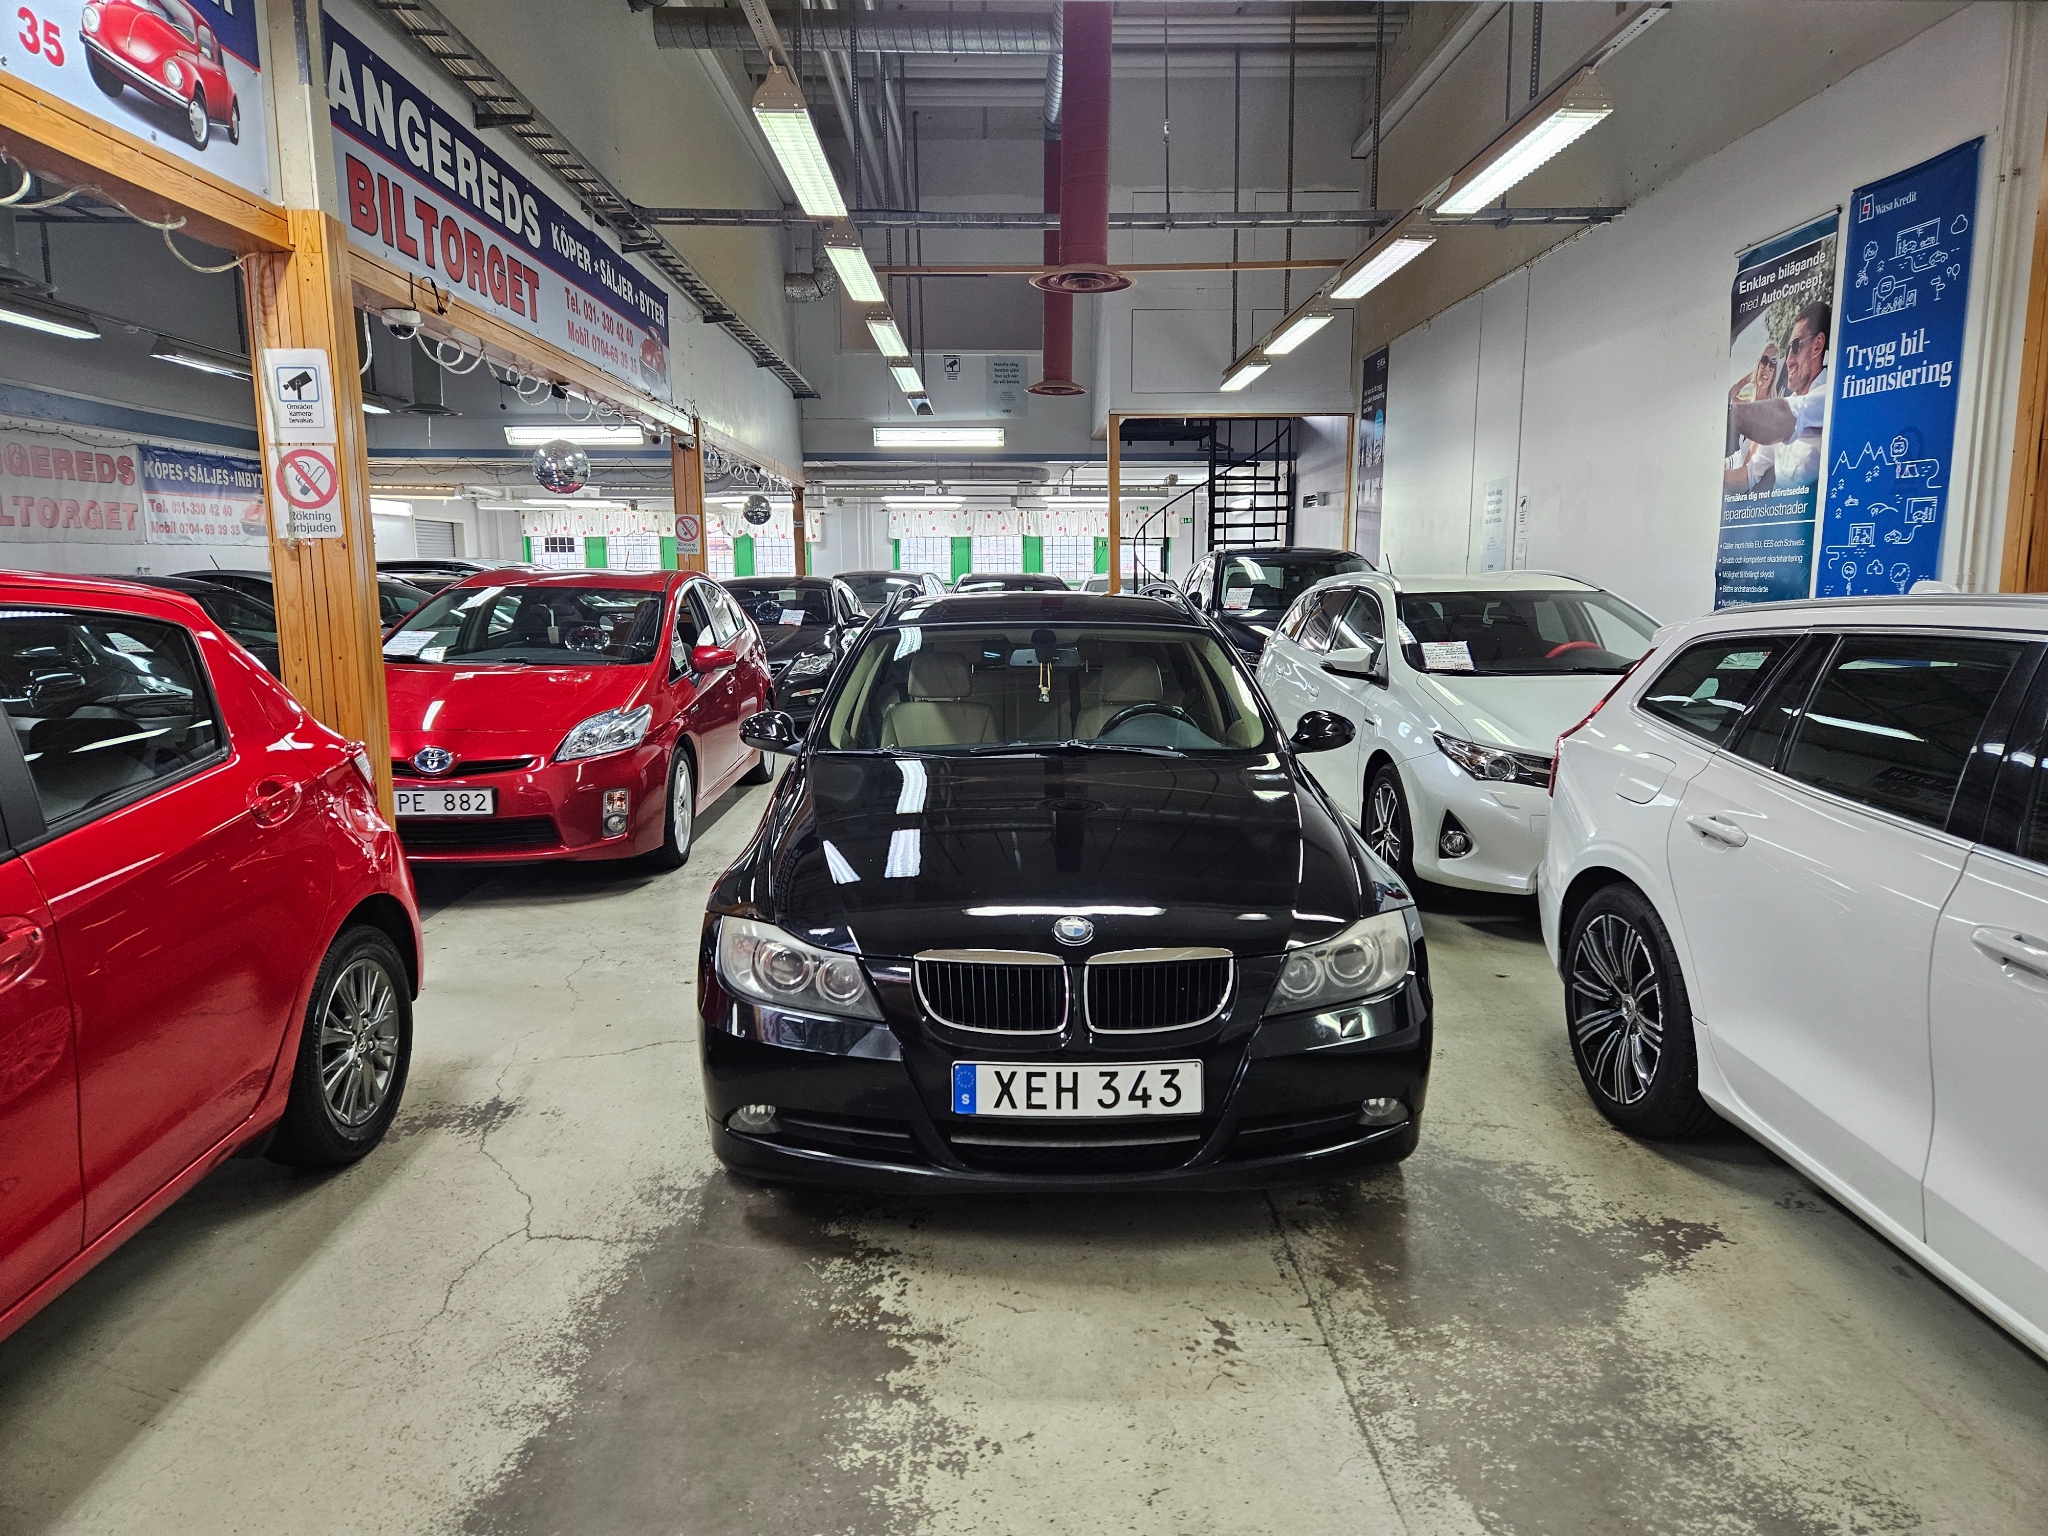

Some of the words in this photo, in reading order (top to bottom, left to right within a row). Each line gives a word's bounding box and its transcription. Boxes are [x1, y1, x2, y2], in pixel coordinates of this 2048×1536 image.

[18, 7, 65, 67] 35
[329, 42, 541, 249] ANGEREDS
[551, 222, 592, 274] KÖPER
[600, 258, 634, 306] SÄLJER
[639, 290, 665, 328] BYTER
[1875, 202, 1893, 215] Wasa
[1893, 191, 1917, 209] Kredit
[346, 152, 540, 323] BILTORGET
[1739, 272, 1776, 295] Enklare
[1778, 250, 1826, 280] bilägande
[1740, 295, 1759, 314] med
[1760, 271, 1824, 307] AutoConcept
[565, 286, 581, 316] Tel.
[602, 311, 614, 336] 330
[616, 321, 624, 342] 42
[626, 327, 634, 348] 40
[568, 319, 589, 349] Mobil
[621, 351, 628, 370] 39
[630, 356, 638, 375] 35
[1846, 341, 1897, 371] Trygg
[1900, 327, 1931, 357] bil-
[1841, 360, 1954, 399] finansiering
[286, 403, 313, 411] Området
[148, 499, 168, 514] Tel.
[209, 504, 219, 516] 42
[222, 505, 232, 517] 40
[1723, 500, 1809, 522] reparationskostnader
[1724, 492, 1748, 503] Försäkra
[1748, 492, 1758, 501] dig
[1758, 490, 1771, 499] mot
[150, 521, 176, 534] Mobil
[218, 524, 228, 536] 39
[230, 524, 240, 535] 35
[444, 793, 487, 812] 882
[961, 1093, 970, 1105] S
[993, 1070, 1079, 1110] XEH
[1097, 1069, 1182, 1109] 343
